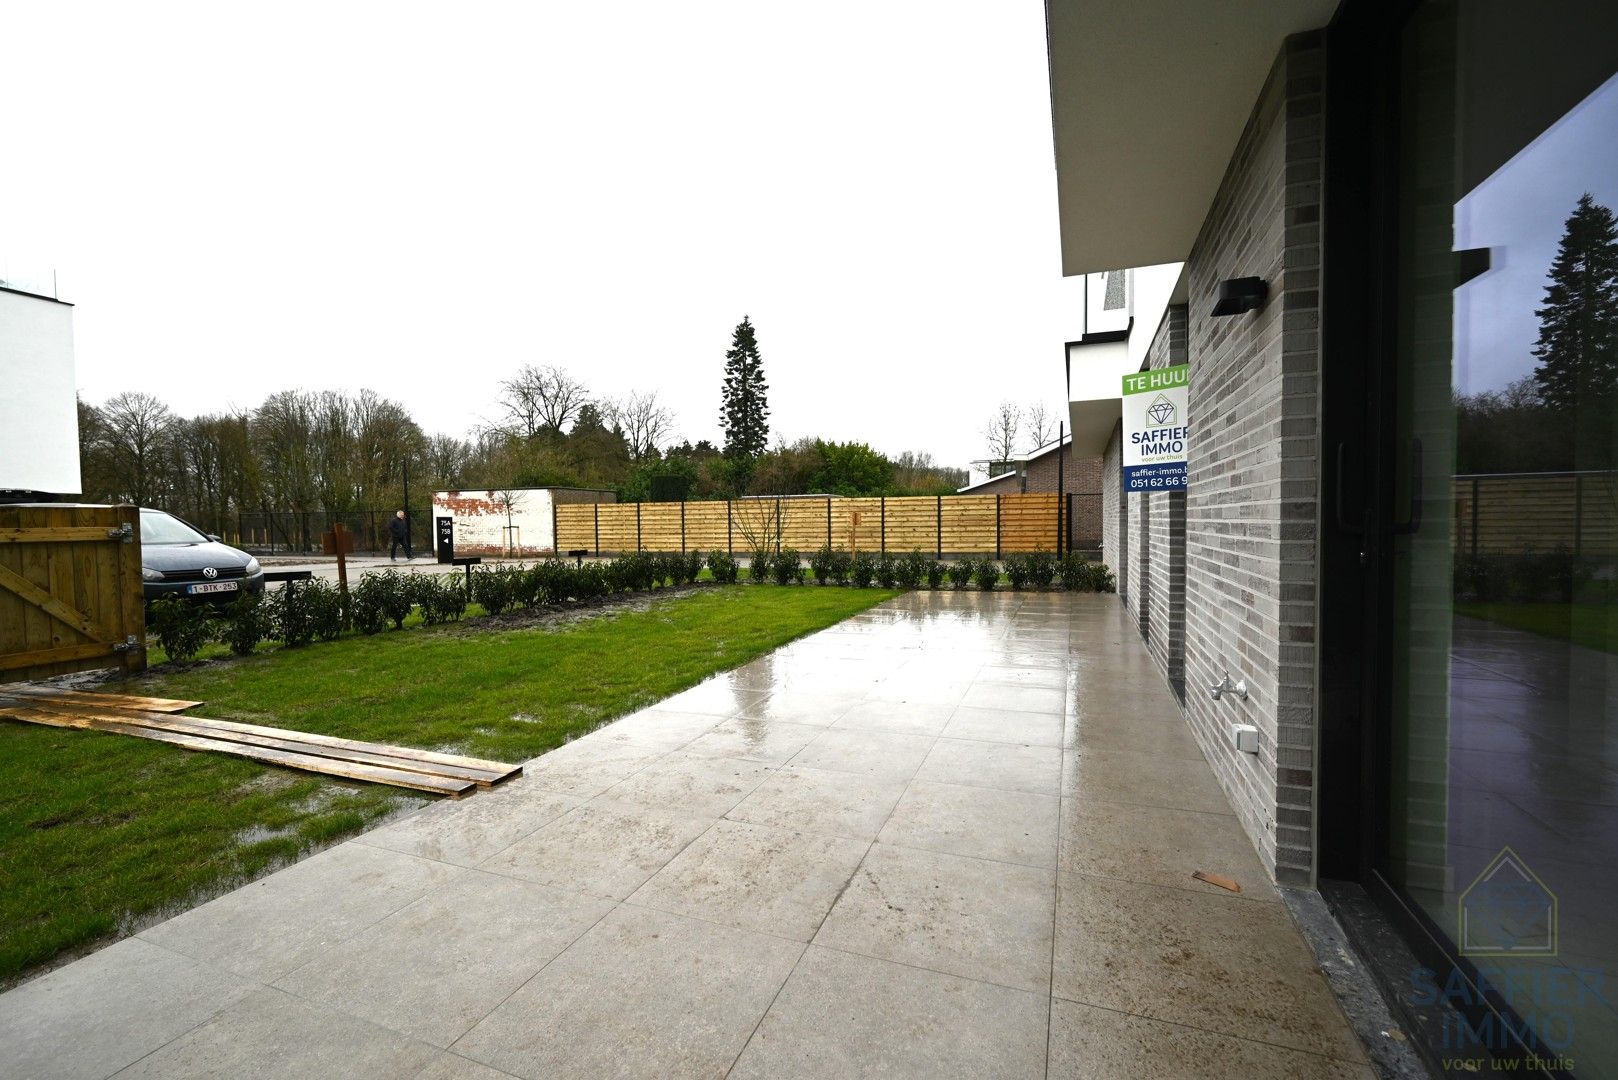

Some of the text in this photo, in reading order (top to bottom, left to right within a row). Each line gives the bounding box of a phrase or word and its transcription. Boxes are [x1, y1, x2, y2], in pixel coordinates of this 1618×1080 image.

[1126, 369, 1189, 391] TE HUU
[1141, 440, 1183, 456] IMMO
[1131, 479, 1148, 488] 051
[1150, 478, 1163, 487] 62
[1165, 477, 1179, 486] 66
